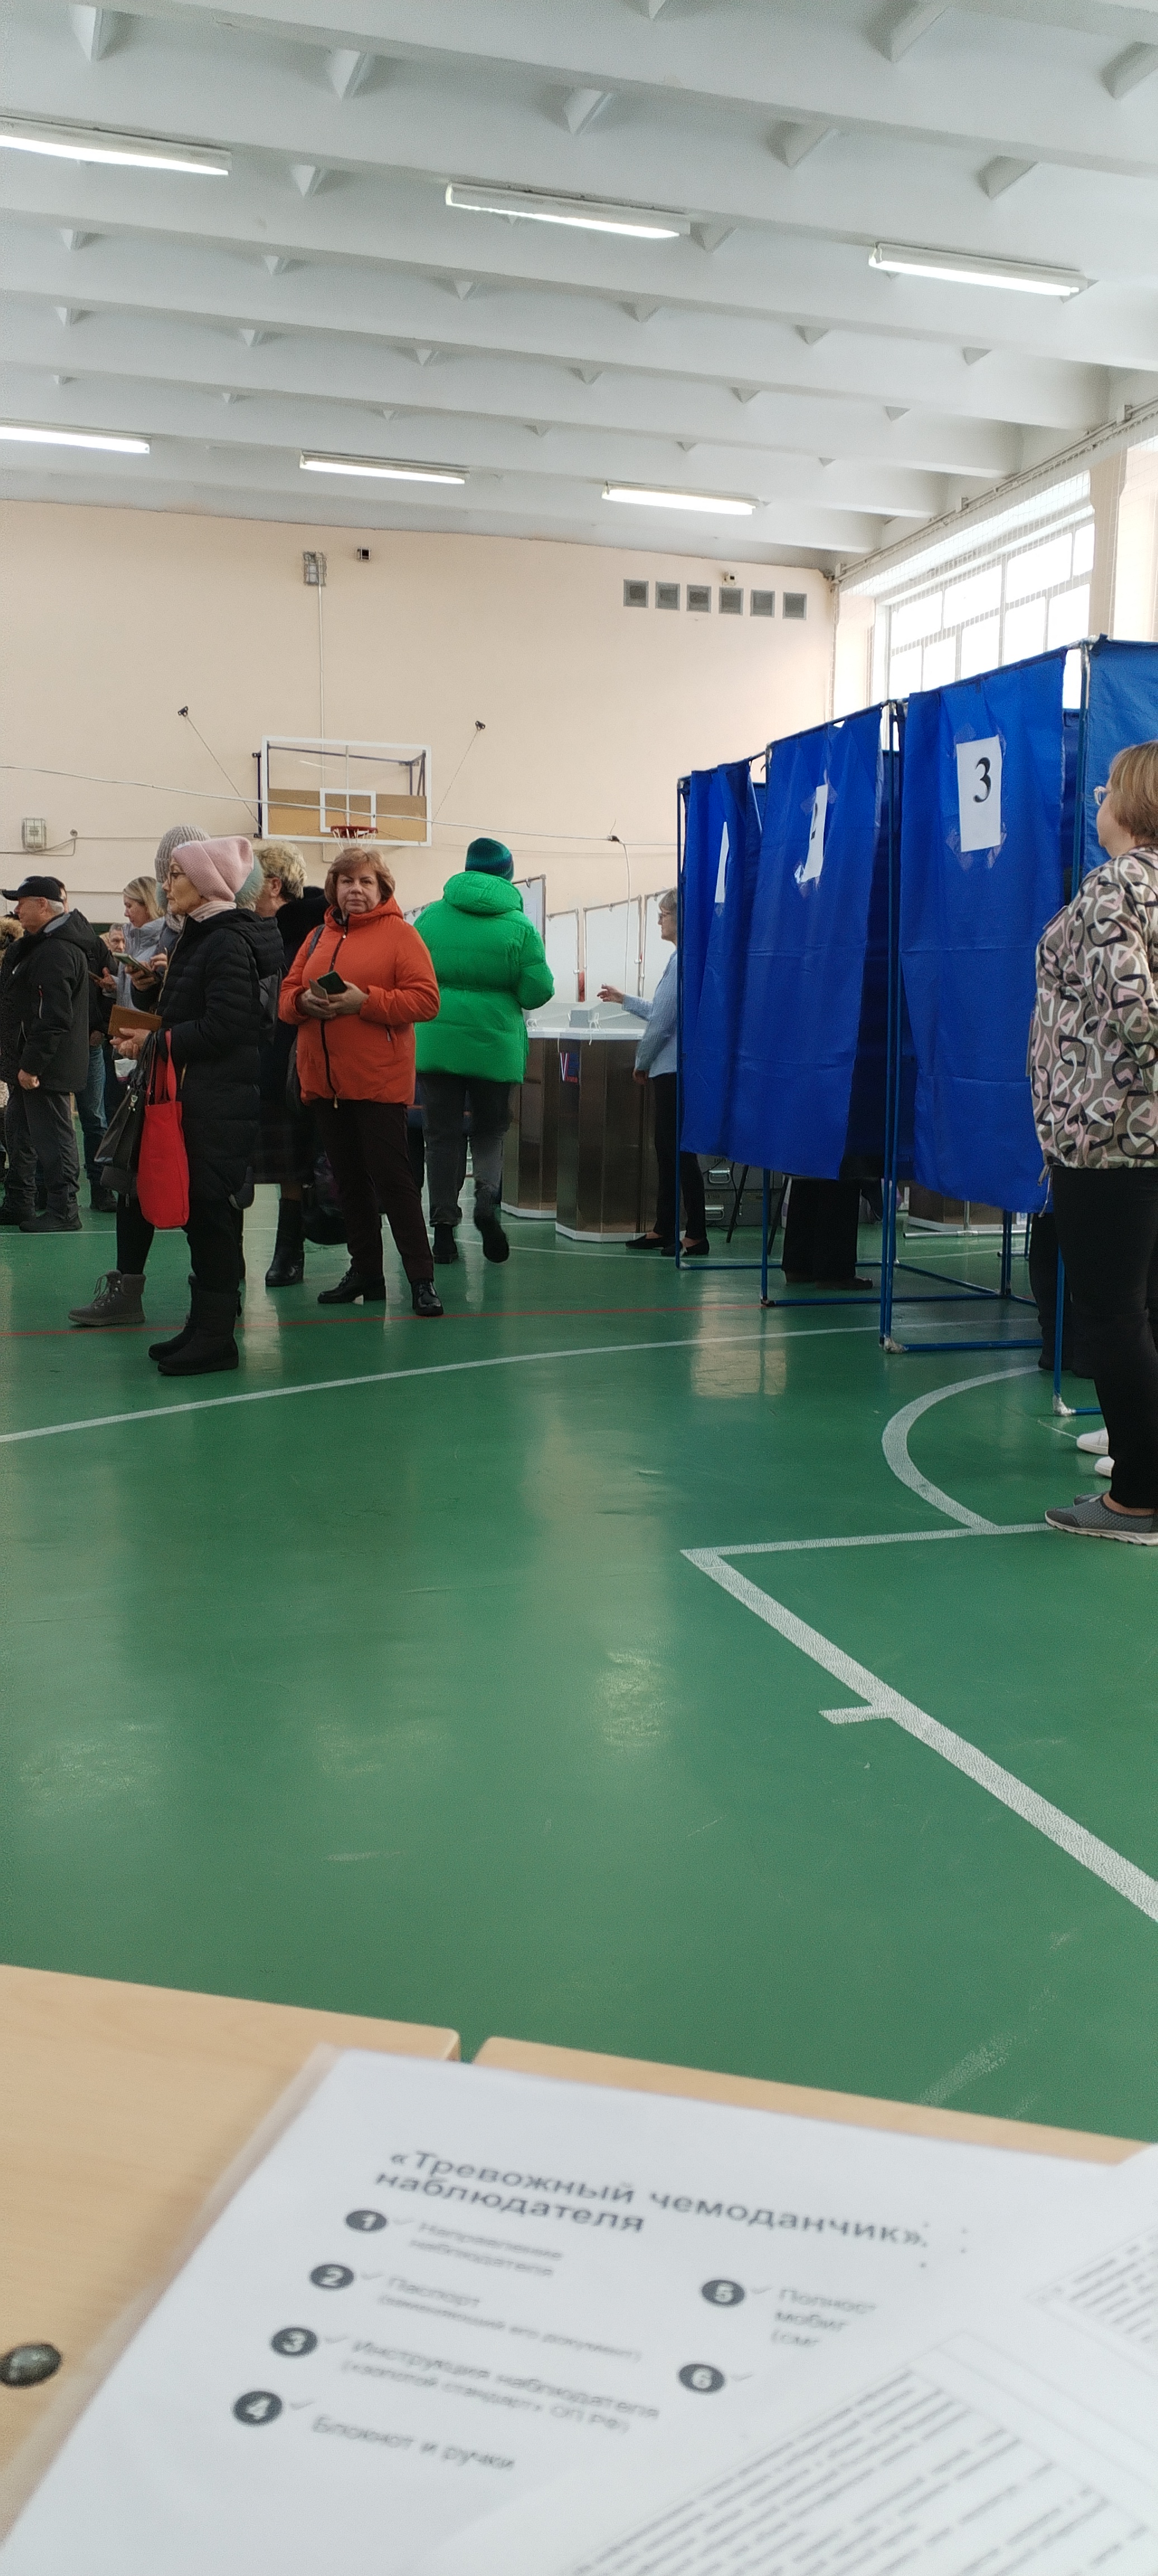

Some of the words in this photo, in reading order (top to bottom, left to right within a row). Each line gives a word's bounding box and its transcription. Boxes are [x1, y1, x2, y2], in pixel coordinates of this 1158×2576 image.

[974, 757, 991, 802] 3
[390, 2150, 635, 2204] «Тревожный
[376, 2172, 644, 2233] наблюдателя
[321, 2267, 343, 2286] 2
[389, 2276, 480, 2308] Паспорт
[713, 2283, 734, 2303] 5
[283, 2330, 307, 2352] 3
[352, 2339, 490, 2379] Инструкция
[496, 2374, 659, 2419] наблюдателя
[691, 2368, 713, 2389] 6
[245, 2397, 272, 2420] 4
[313, 2416, 414, 2450] Блокнот
[420, 2441, 437, 2454] и
[442, 2445, 515, 2470] ручки
